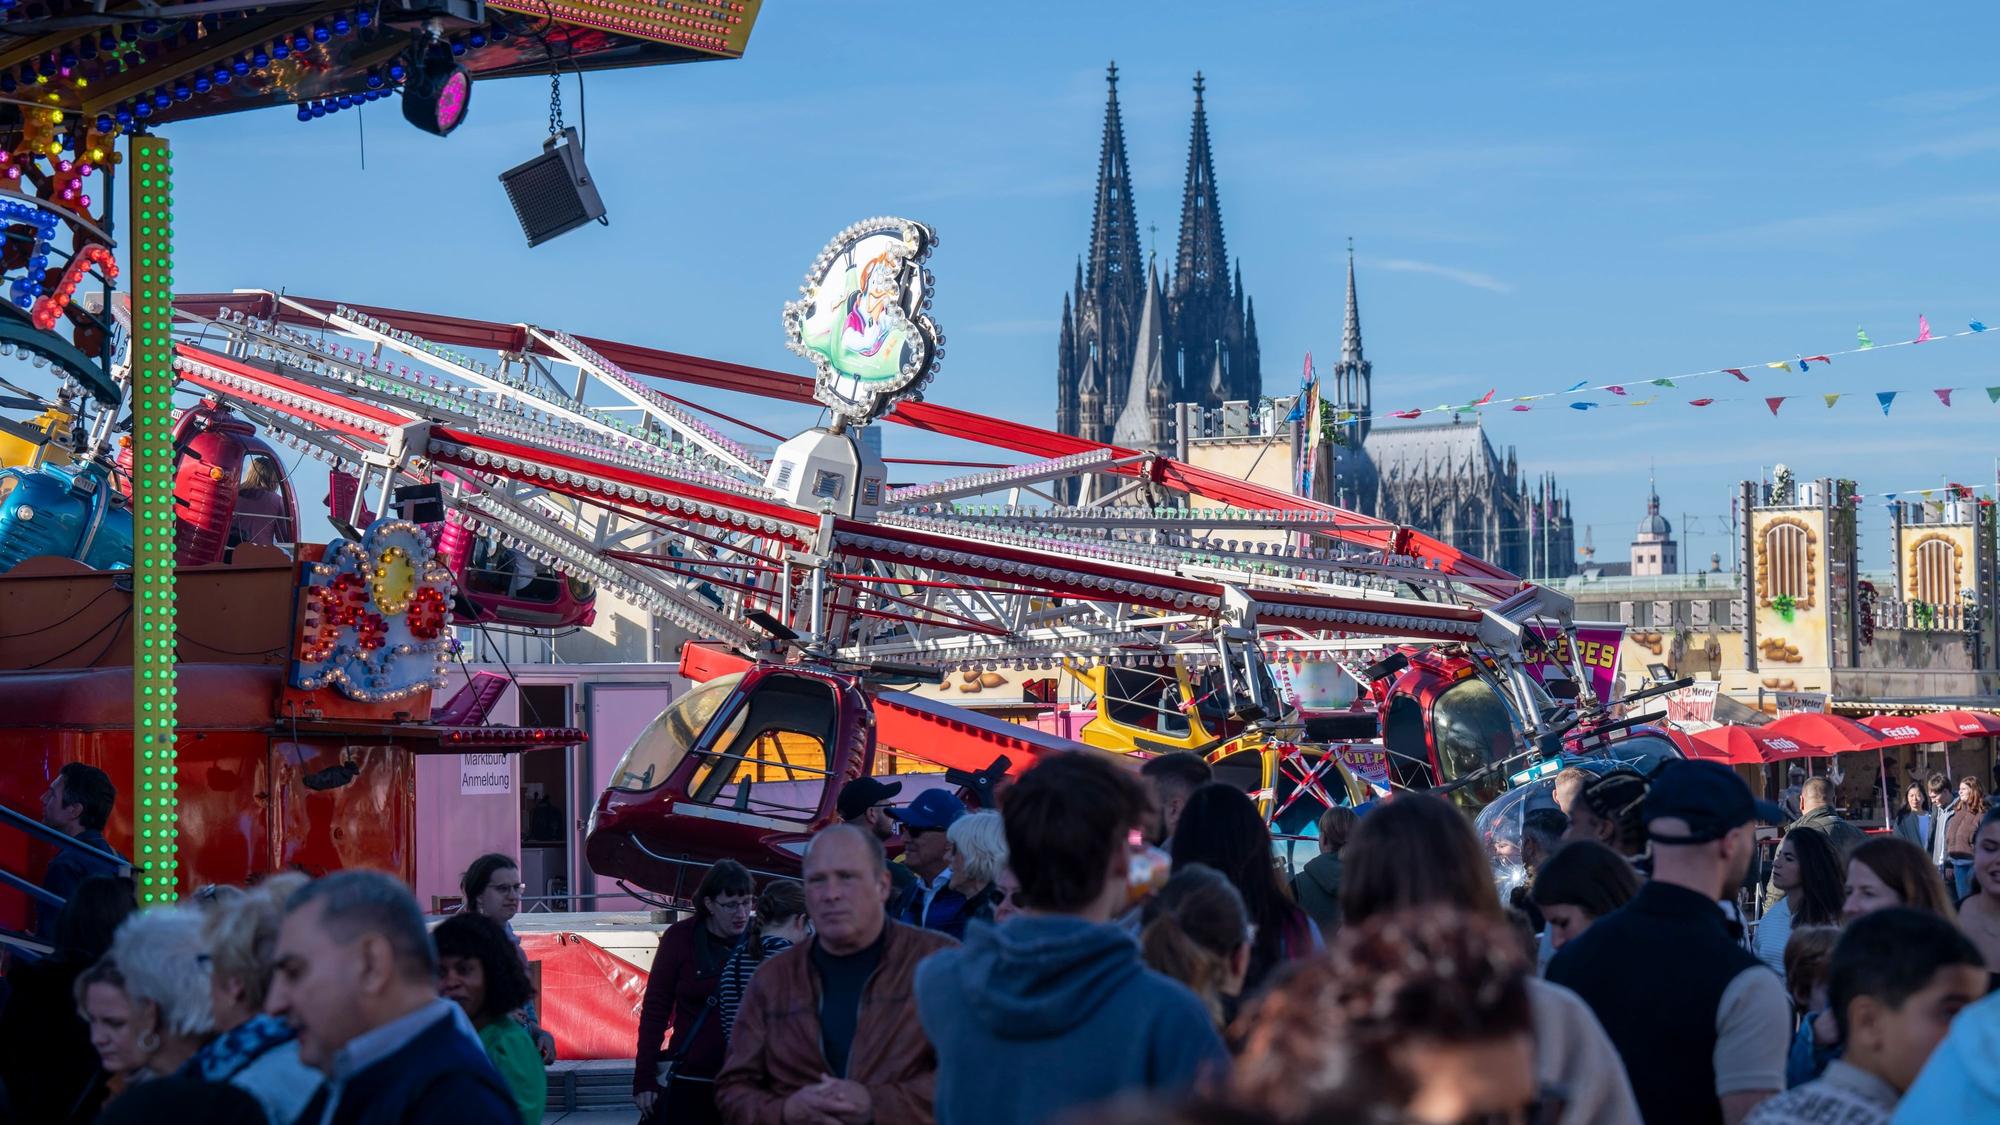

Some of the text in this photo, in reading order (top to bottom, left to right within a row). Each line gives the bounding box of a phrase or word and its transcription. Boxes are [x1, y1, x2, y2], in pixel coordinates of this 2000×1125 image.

[1692, 687, 1713, 698] Meter
[1788, 696, 1801, 708] 1/2
[1802, 698, 1822, 709] Meter
[462, 772, 509, 789] Anmeldung
